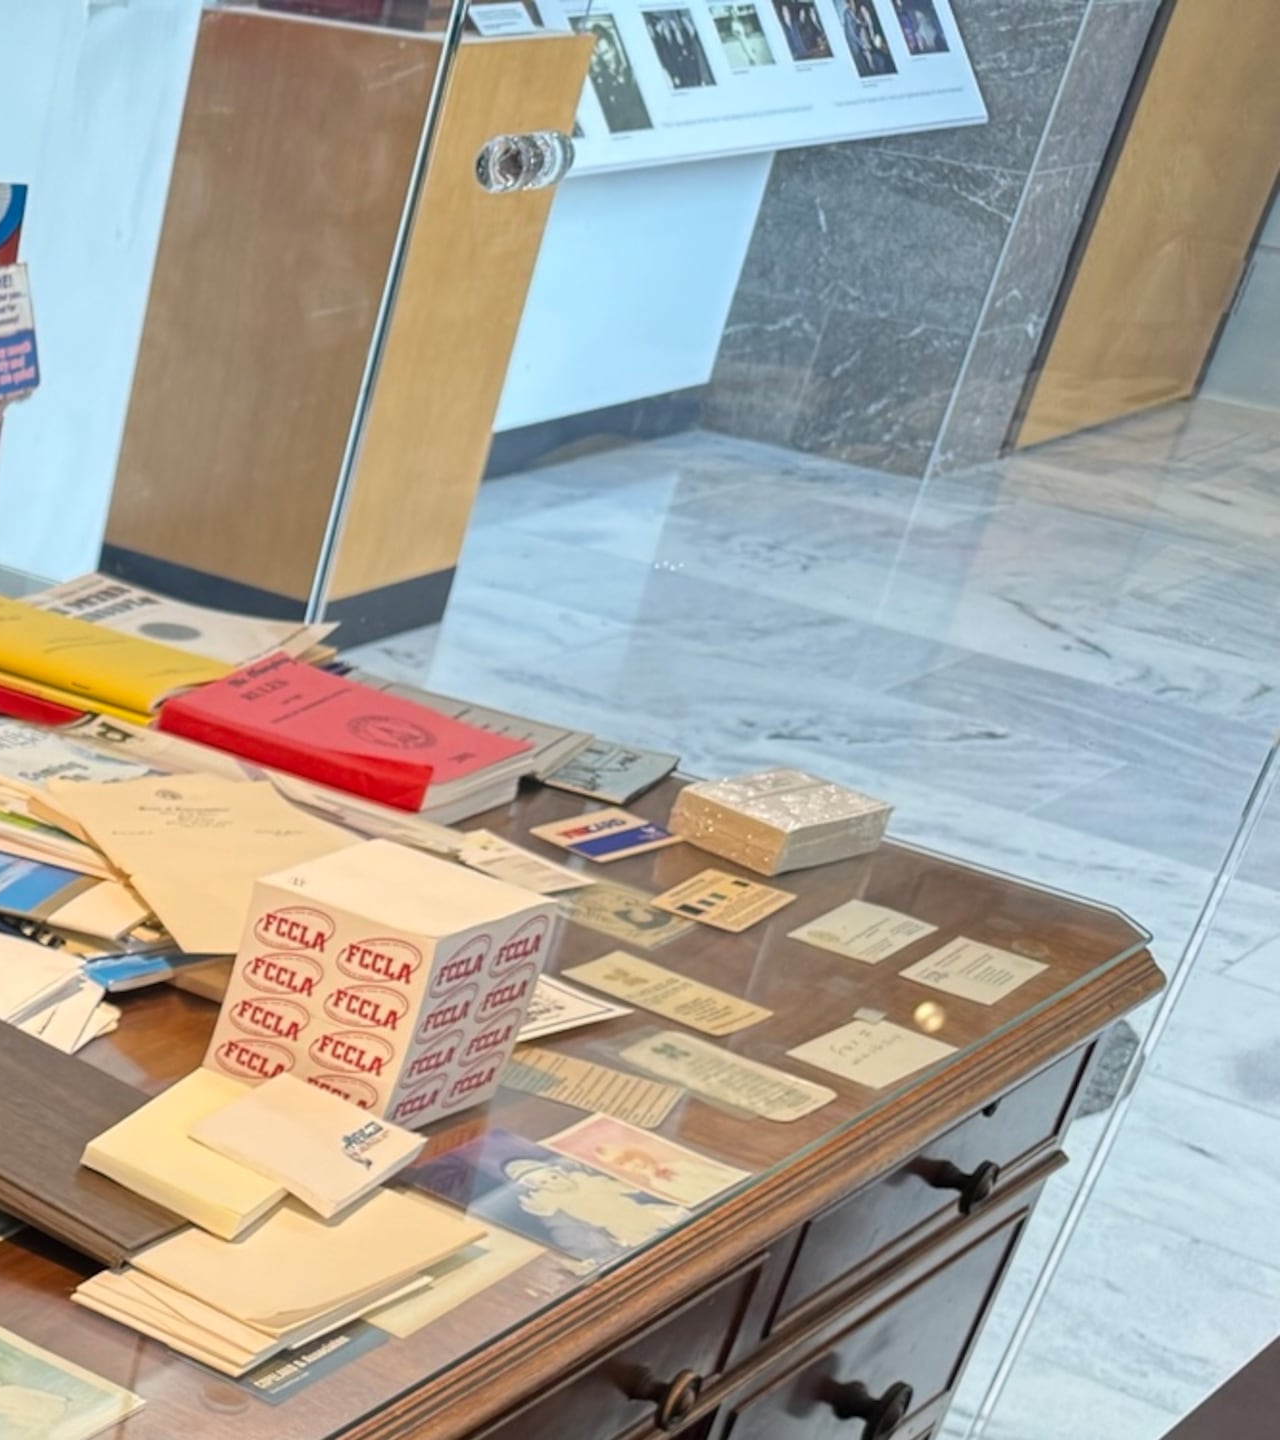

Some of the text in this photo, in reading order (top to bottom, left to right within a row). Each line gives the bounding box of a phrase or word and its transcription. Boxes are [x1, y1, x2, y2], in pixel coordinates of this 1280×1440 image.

[262, 913, 326, 953] FCCLA
[344, 943, 413, 984] FCCLA
[495, 935, 542, 966] FCCLA
[249, 956, 314, 997] FCCLA
[435, 955, 484, 987] FCCLA
[333, 988, 399, 1031] FCCLA
[480, 980, 528, 1011] FCCLA
[238, 1000, 300, 1042] FCCLA
[421, 1001, 473, 1034] FCCLA
[319, 1034, 384, 1077] FCCLA
[466, 1026, 514, 1057] FCCLA
[224, 1040, 290, 1079] FCCLA
[406, 1045, 457, 1079] FCCLA
[451, 1067, 497, 1099] FCCLA
[392, 1089, 440, 1122] FCCLA
